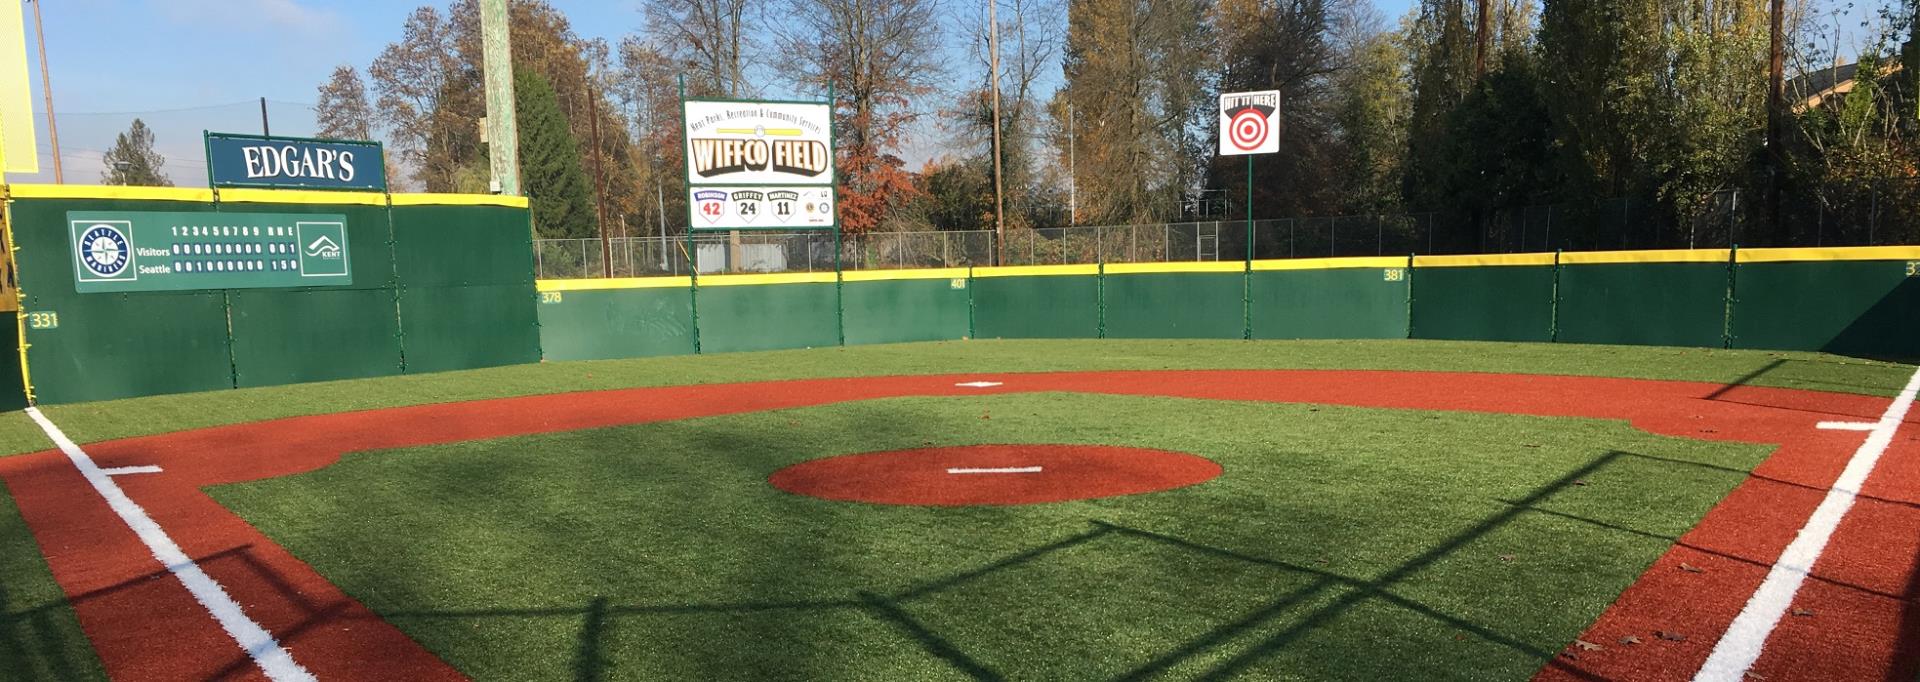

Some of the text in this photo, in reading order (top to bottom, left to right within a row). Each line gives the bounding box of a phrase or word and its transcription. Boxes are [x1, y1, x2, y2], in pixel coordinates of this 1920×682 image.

[1224, 94, 1276, 111] HIT IT HERE
[726, 110, 758, 120] Recreation
[759, 108, 764, 118] &
[766, 109, 798, 125] Community
[242, 145, 354, 182] EDGAR'S
[691, 138, 828, 177] WIFFCO FIELD
[733, 191, 762, 200] GRIFFEY
[768, 191, 798, 200] MARTINEZ
[703, 202, 720, 216] 42
[740, 202, 756, 215] 24
[777, 202, 790, 215] 11
[84, 229, 123, 246] SEATTLE
[136, 247, 170, 257] Visitors
[138, 264, 171, 274] Seattle
[1384, 268, 1403, 280] 381
[951, 278, 965, 288] 401
[542, 292, 562, 304] 378
[32, 313, 58, 328] 331
